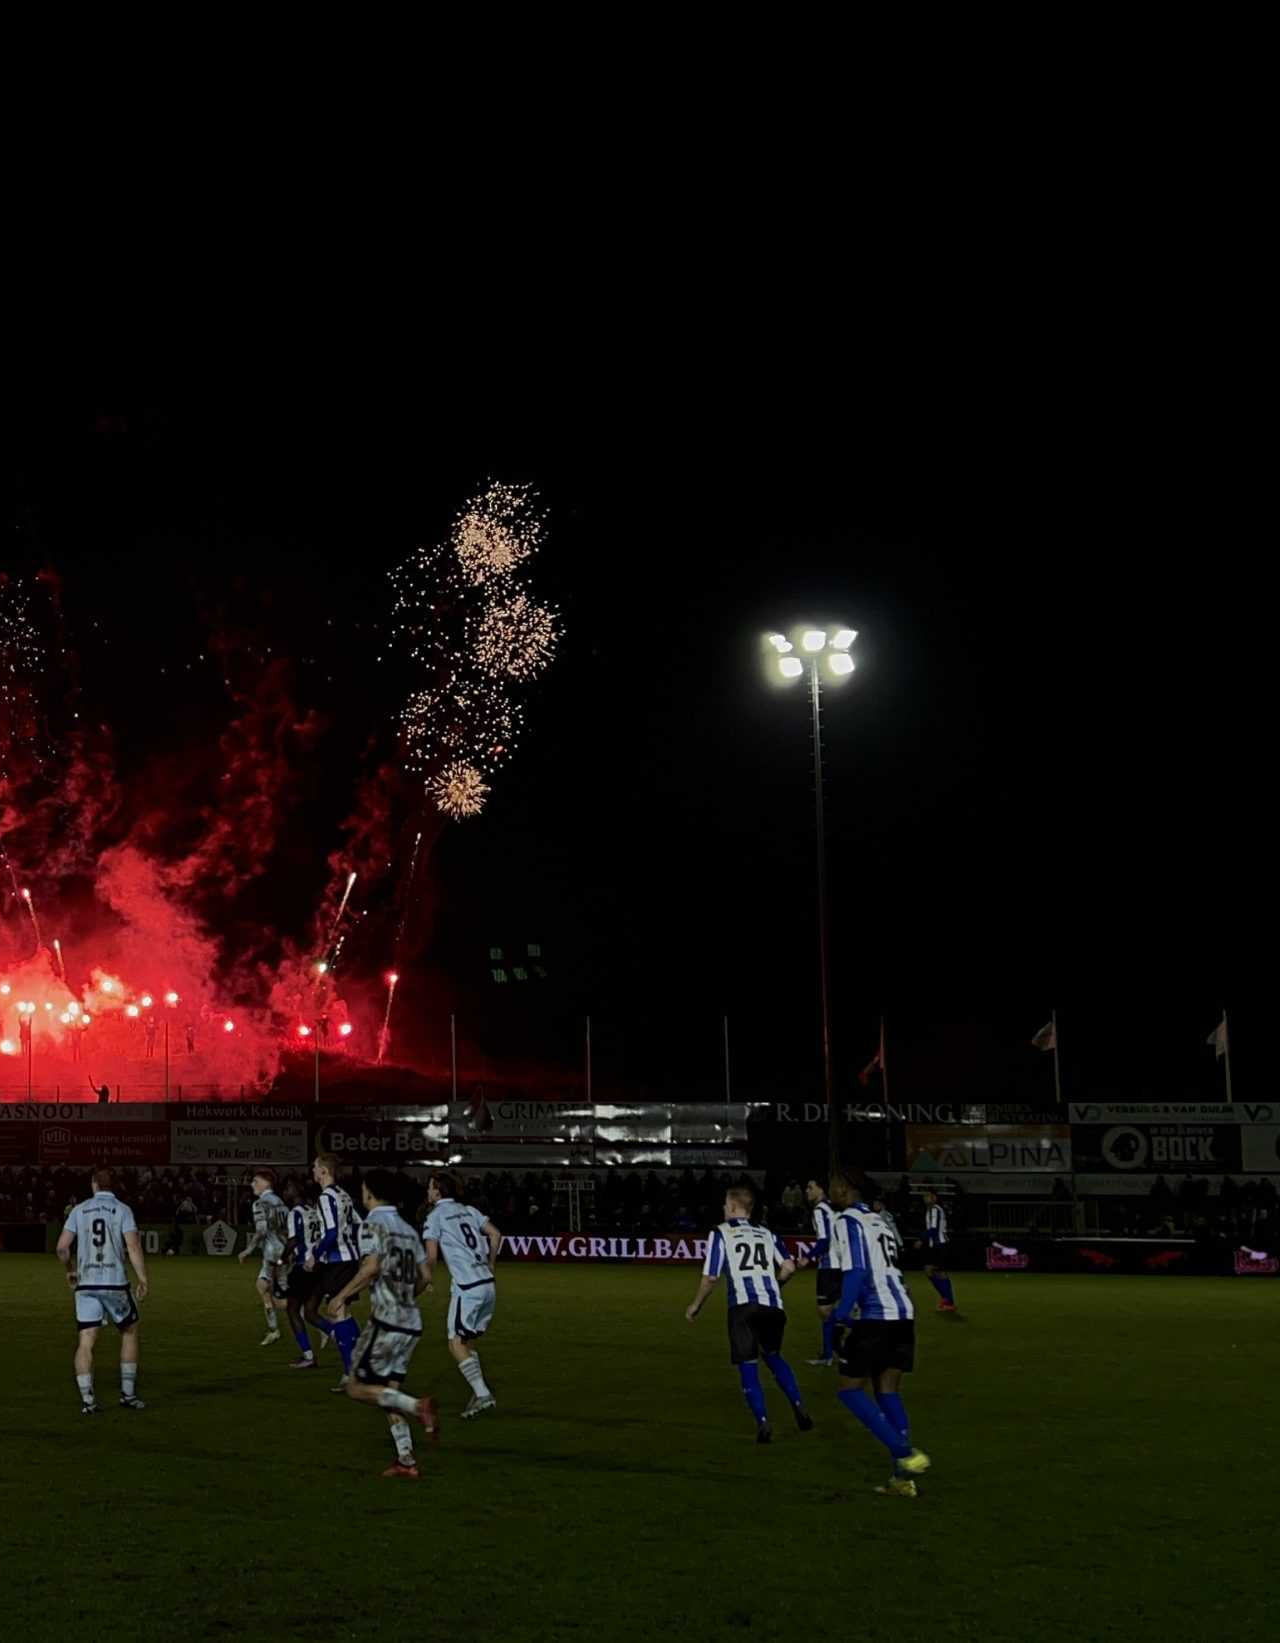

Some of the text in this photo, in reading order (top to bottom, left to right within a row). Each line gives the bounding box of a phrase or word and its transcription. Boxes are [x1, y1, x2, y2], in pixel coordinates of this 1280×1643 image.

[186, 1103, 305, 1120] Hekwerk Katwijk
[847, 1102, 956, 1123] KONING
[330, 1132, 390, 1151] Beter
[1151, 1136, 1217, 1161] BOCK
[941, 1143, 1065, 1167] ALPINA
[92, 1218, 106, 1248] 9
[460, 1222, 477, 1249] 8
[735, 1242, 769, 1271] 24
